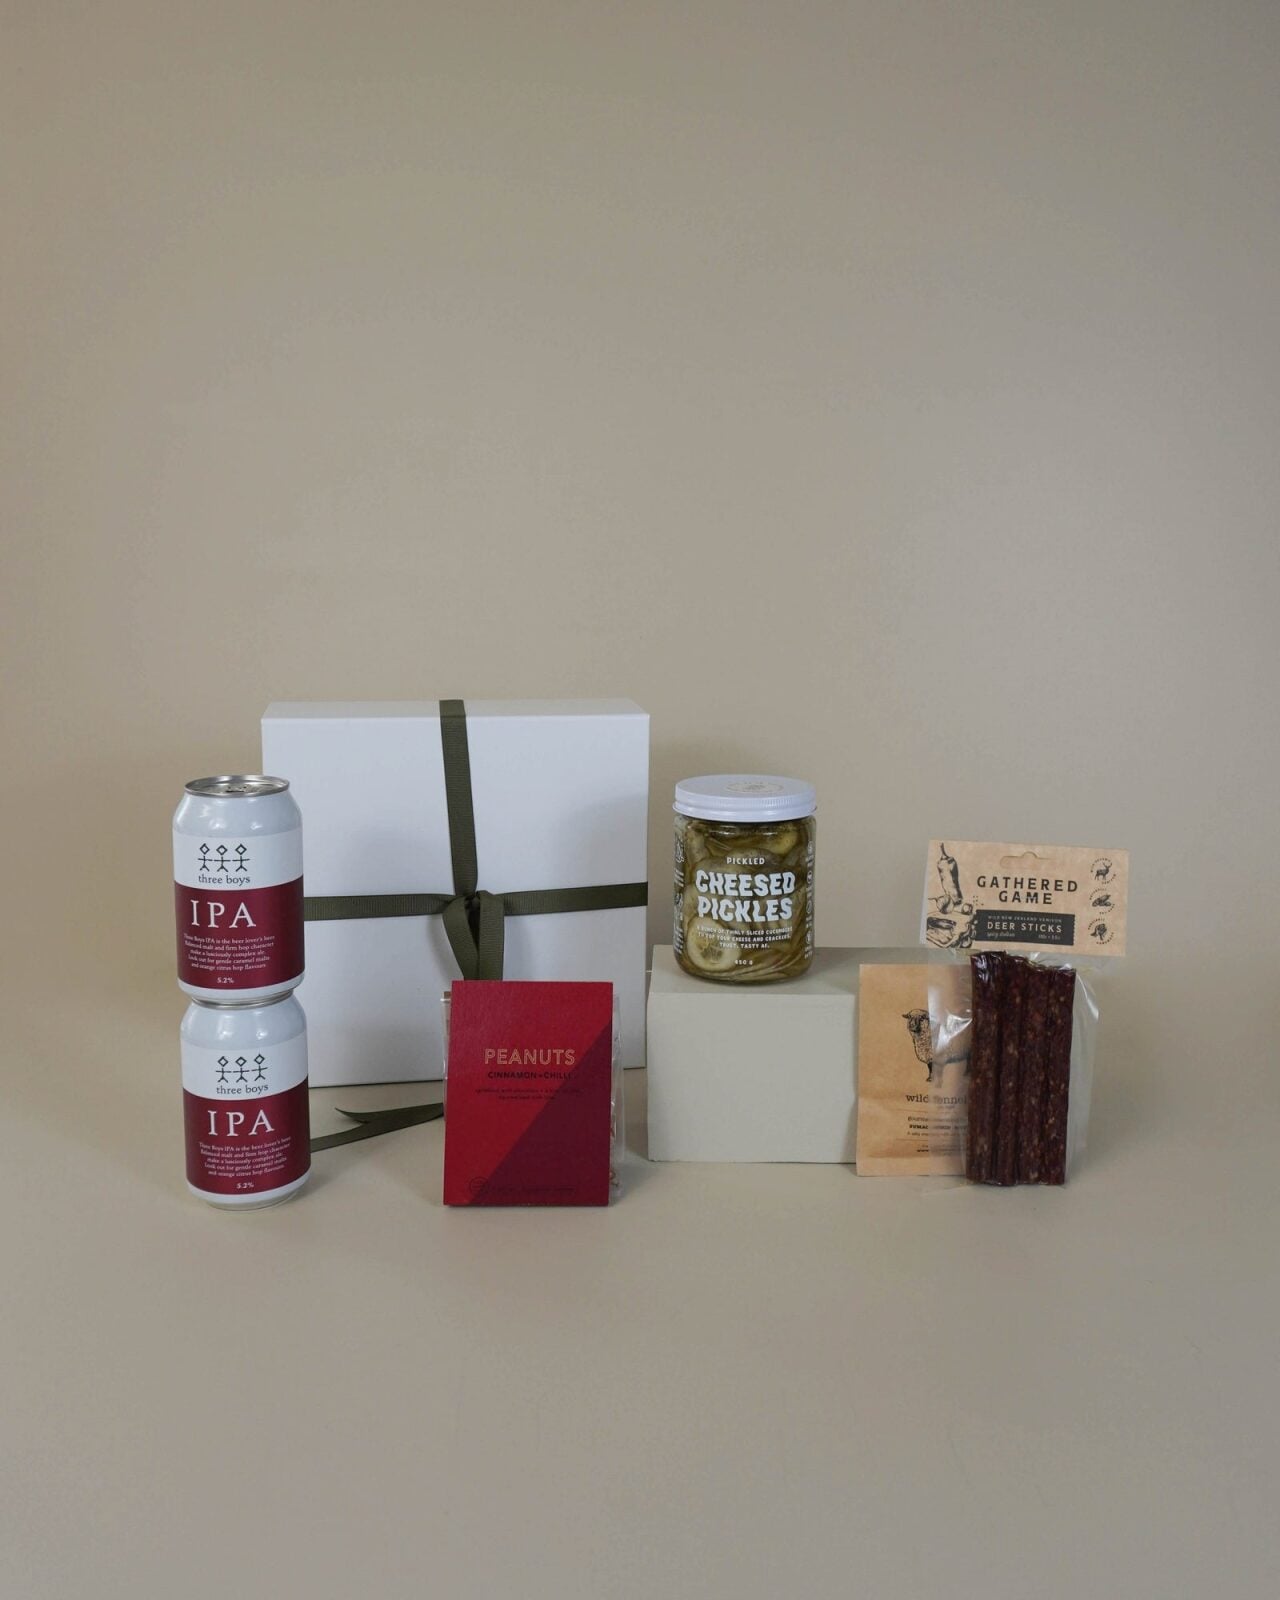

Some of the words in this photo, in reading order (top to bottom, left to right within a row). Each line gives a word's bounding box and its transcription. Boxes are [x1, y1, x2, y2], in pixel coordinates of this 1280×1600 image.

[726, 856, 765, 865] PICKLED
[198, 874, 223, 884] three
[226, 874, 251, 886] boys
[695, 869, 796, 897] CHEESED
[977, 875, 1078, 892] GATHERED
[998, 890, 1053, 905] GAME
[190, 899, 257, 928] IPA
[697, 896, 793, 923] PICKLES
[987, 922, 1015, 930] DEER
[1021, 922, 1062, 933] STICKS
[484, 1048, 576, 1066] PEANUTS
[216, 1085, 242, 1095] three
[245, 1084, 269, 1095] boys
[207, 1109, 275, 1137] IPA
[252, 1154, 274, 1163] complex
[253, 1161, 273, 1169] caramel
